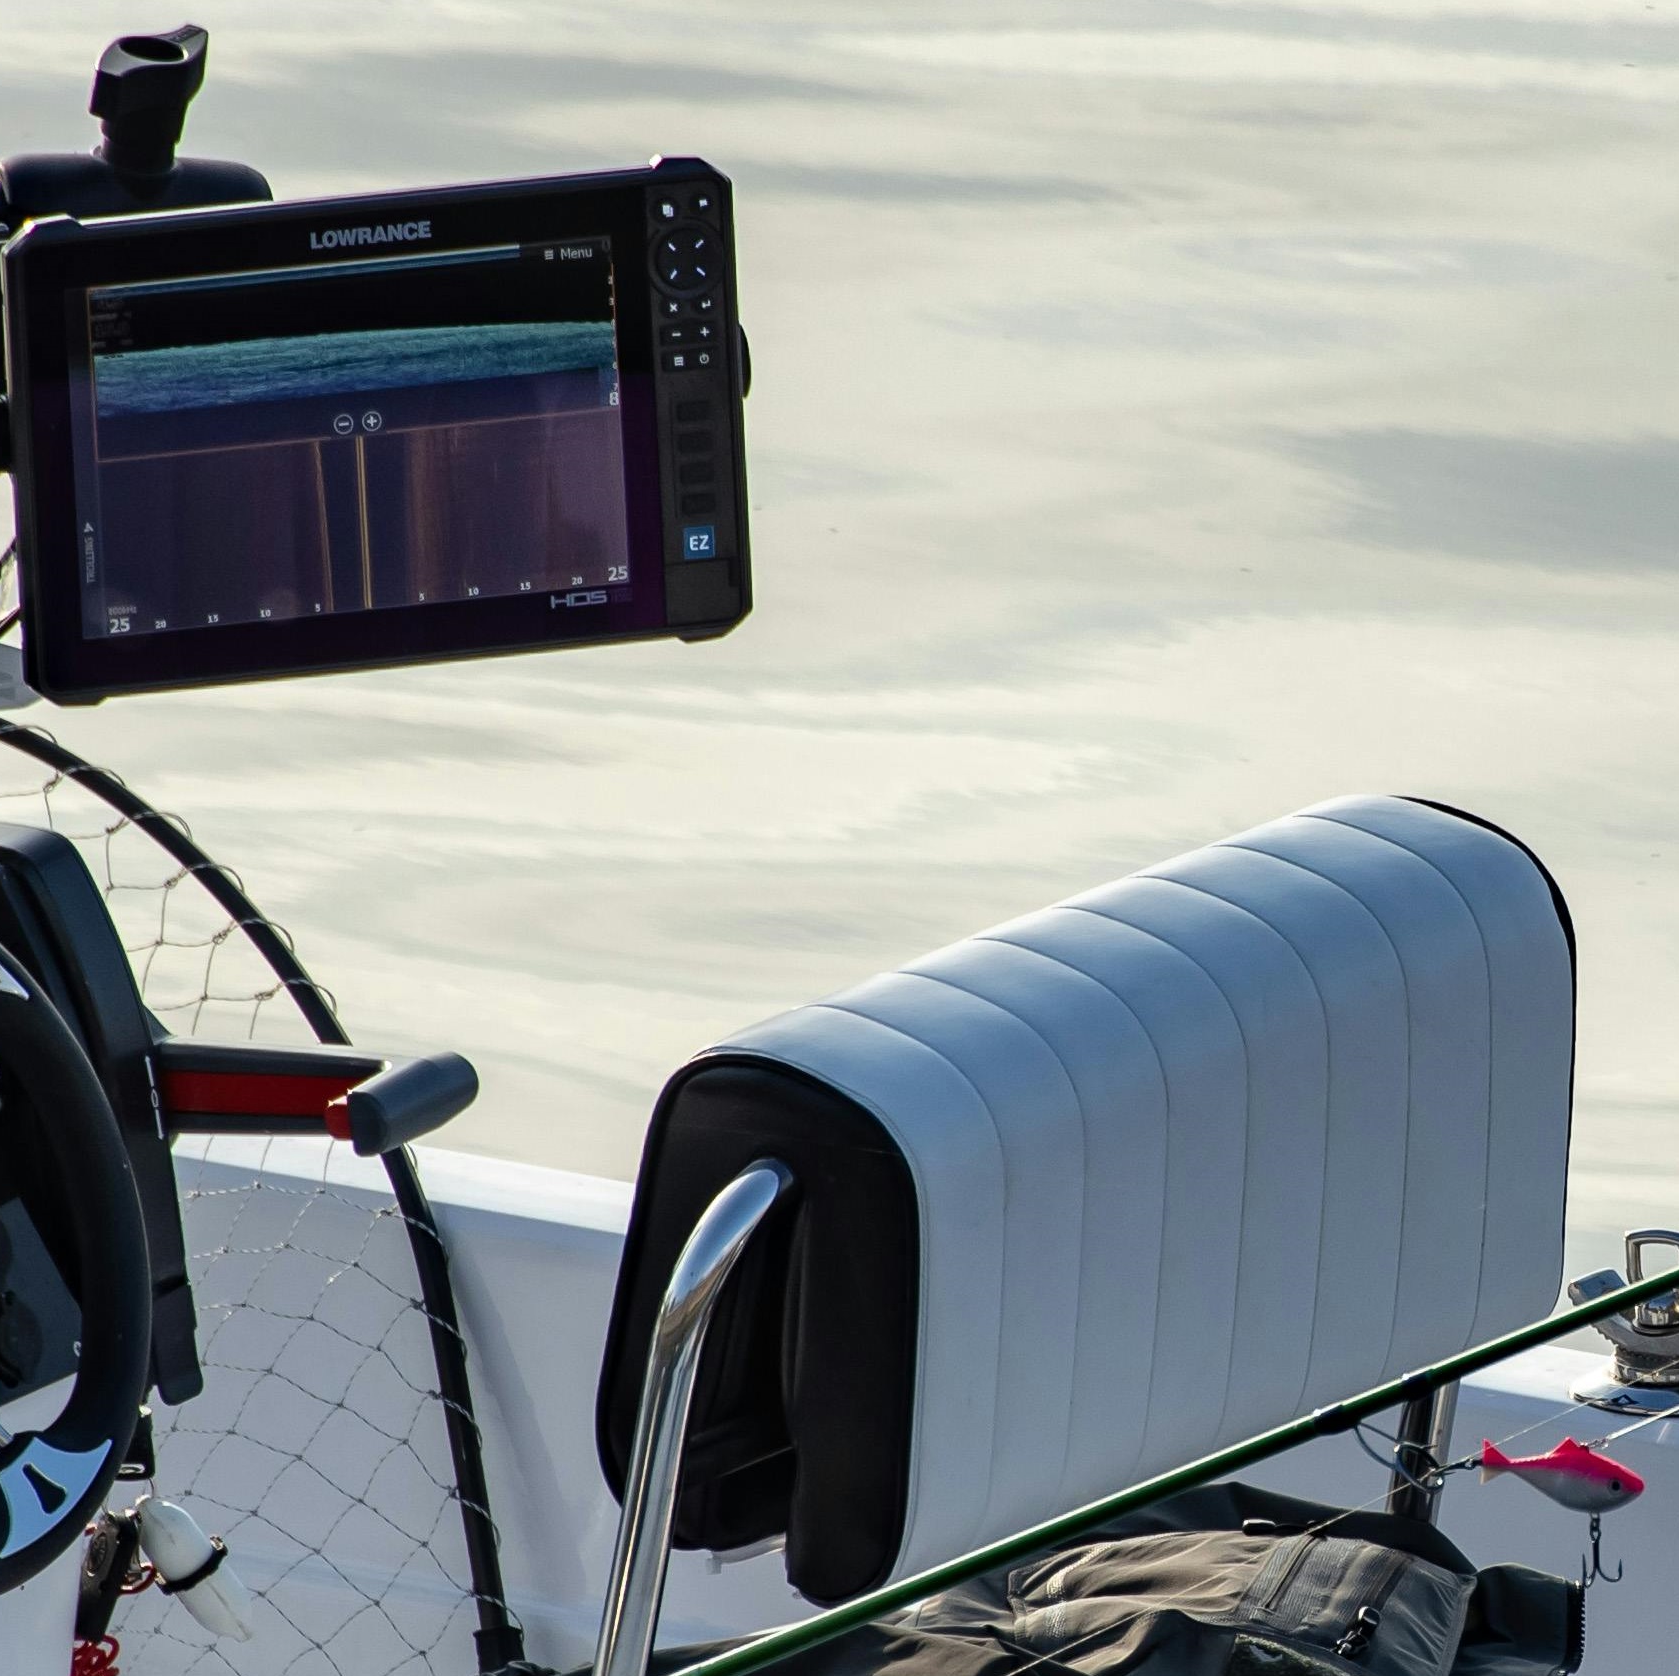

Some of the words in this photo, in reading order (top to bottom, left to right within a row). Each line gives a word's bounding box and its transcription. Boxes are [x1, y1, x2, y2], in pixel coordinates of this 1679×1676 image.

[310, 220, 432, 250] LOWRANCE
[560, 247, 593, 260] Menu
[689, 535, 710, 551] EZ
[109, 618, 131, 634] 25
[155, 620, 167, 630] 20
[207, 613, 219, 623] 15
[259, 608, 271, 618] 10
[314, 603, 321, 612] 5
[419, 592, 425, 602] 5
[468, 587, 480, 597] 10
[520, 581, 531, 591] 15
[571, 576, 583, 586] 20
[608, 566, 628, 582] 25
[550, 590, 608, 609] HDS
